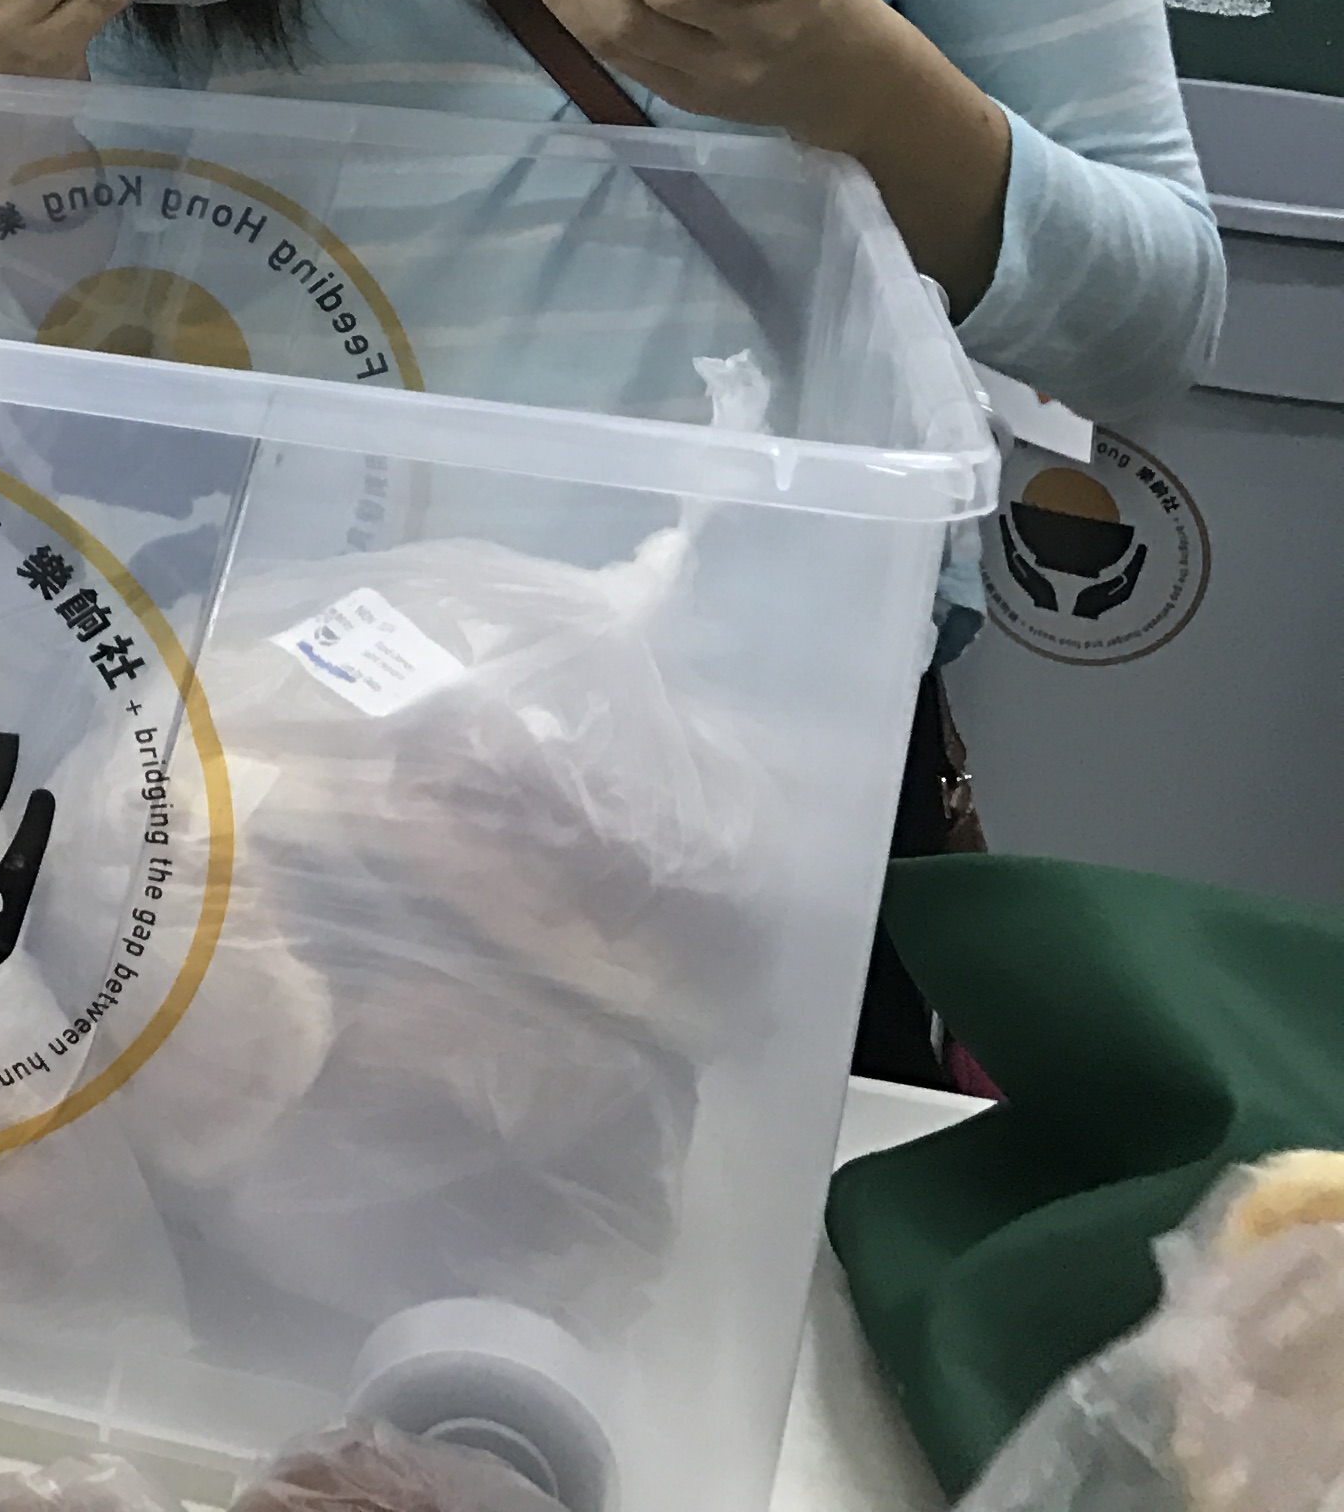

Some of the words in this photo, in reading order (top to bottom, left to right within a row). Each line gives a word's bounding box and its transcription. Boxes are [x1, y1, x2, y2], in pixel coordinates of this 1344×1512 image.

[1096, 441, 1131, 469] ong
[134, 727, 174, 846] bridging
[145, 857, 173, 901] the
[122, 907, 157, 957] gap
[48, 962, 139, 1056] between
